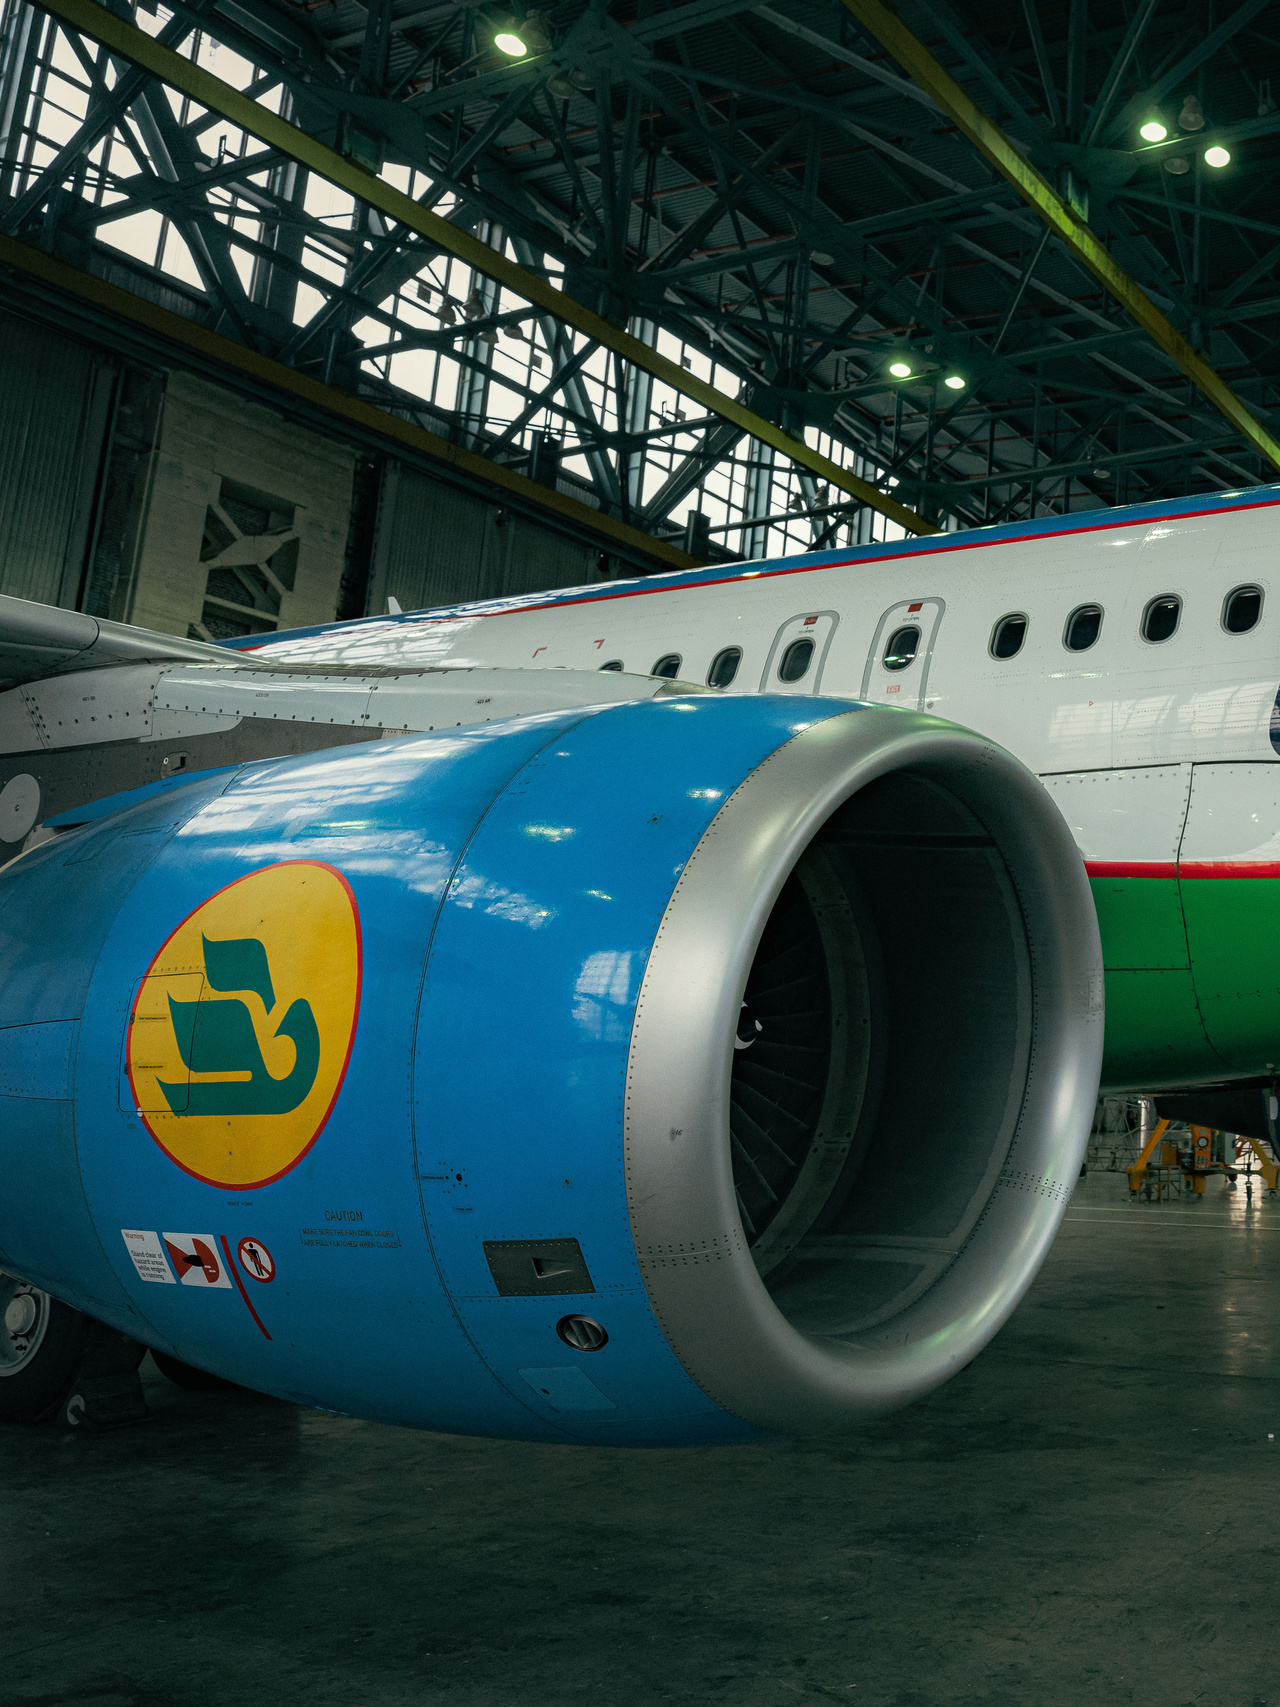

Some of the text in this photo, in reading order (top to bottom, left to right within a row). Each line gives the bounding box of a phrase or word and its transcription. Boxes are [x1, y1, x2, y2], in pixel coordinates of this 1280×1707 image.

[324, 1210, 363, 1221] CAUTION
[124, 1232, 145, 1241] Warning
[333, 1240, 358, 1248] LATCHED
[131, 1249, 145, 1257] Stand
[151, 1266, 166, 1274] engine
